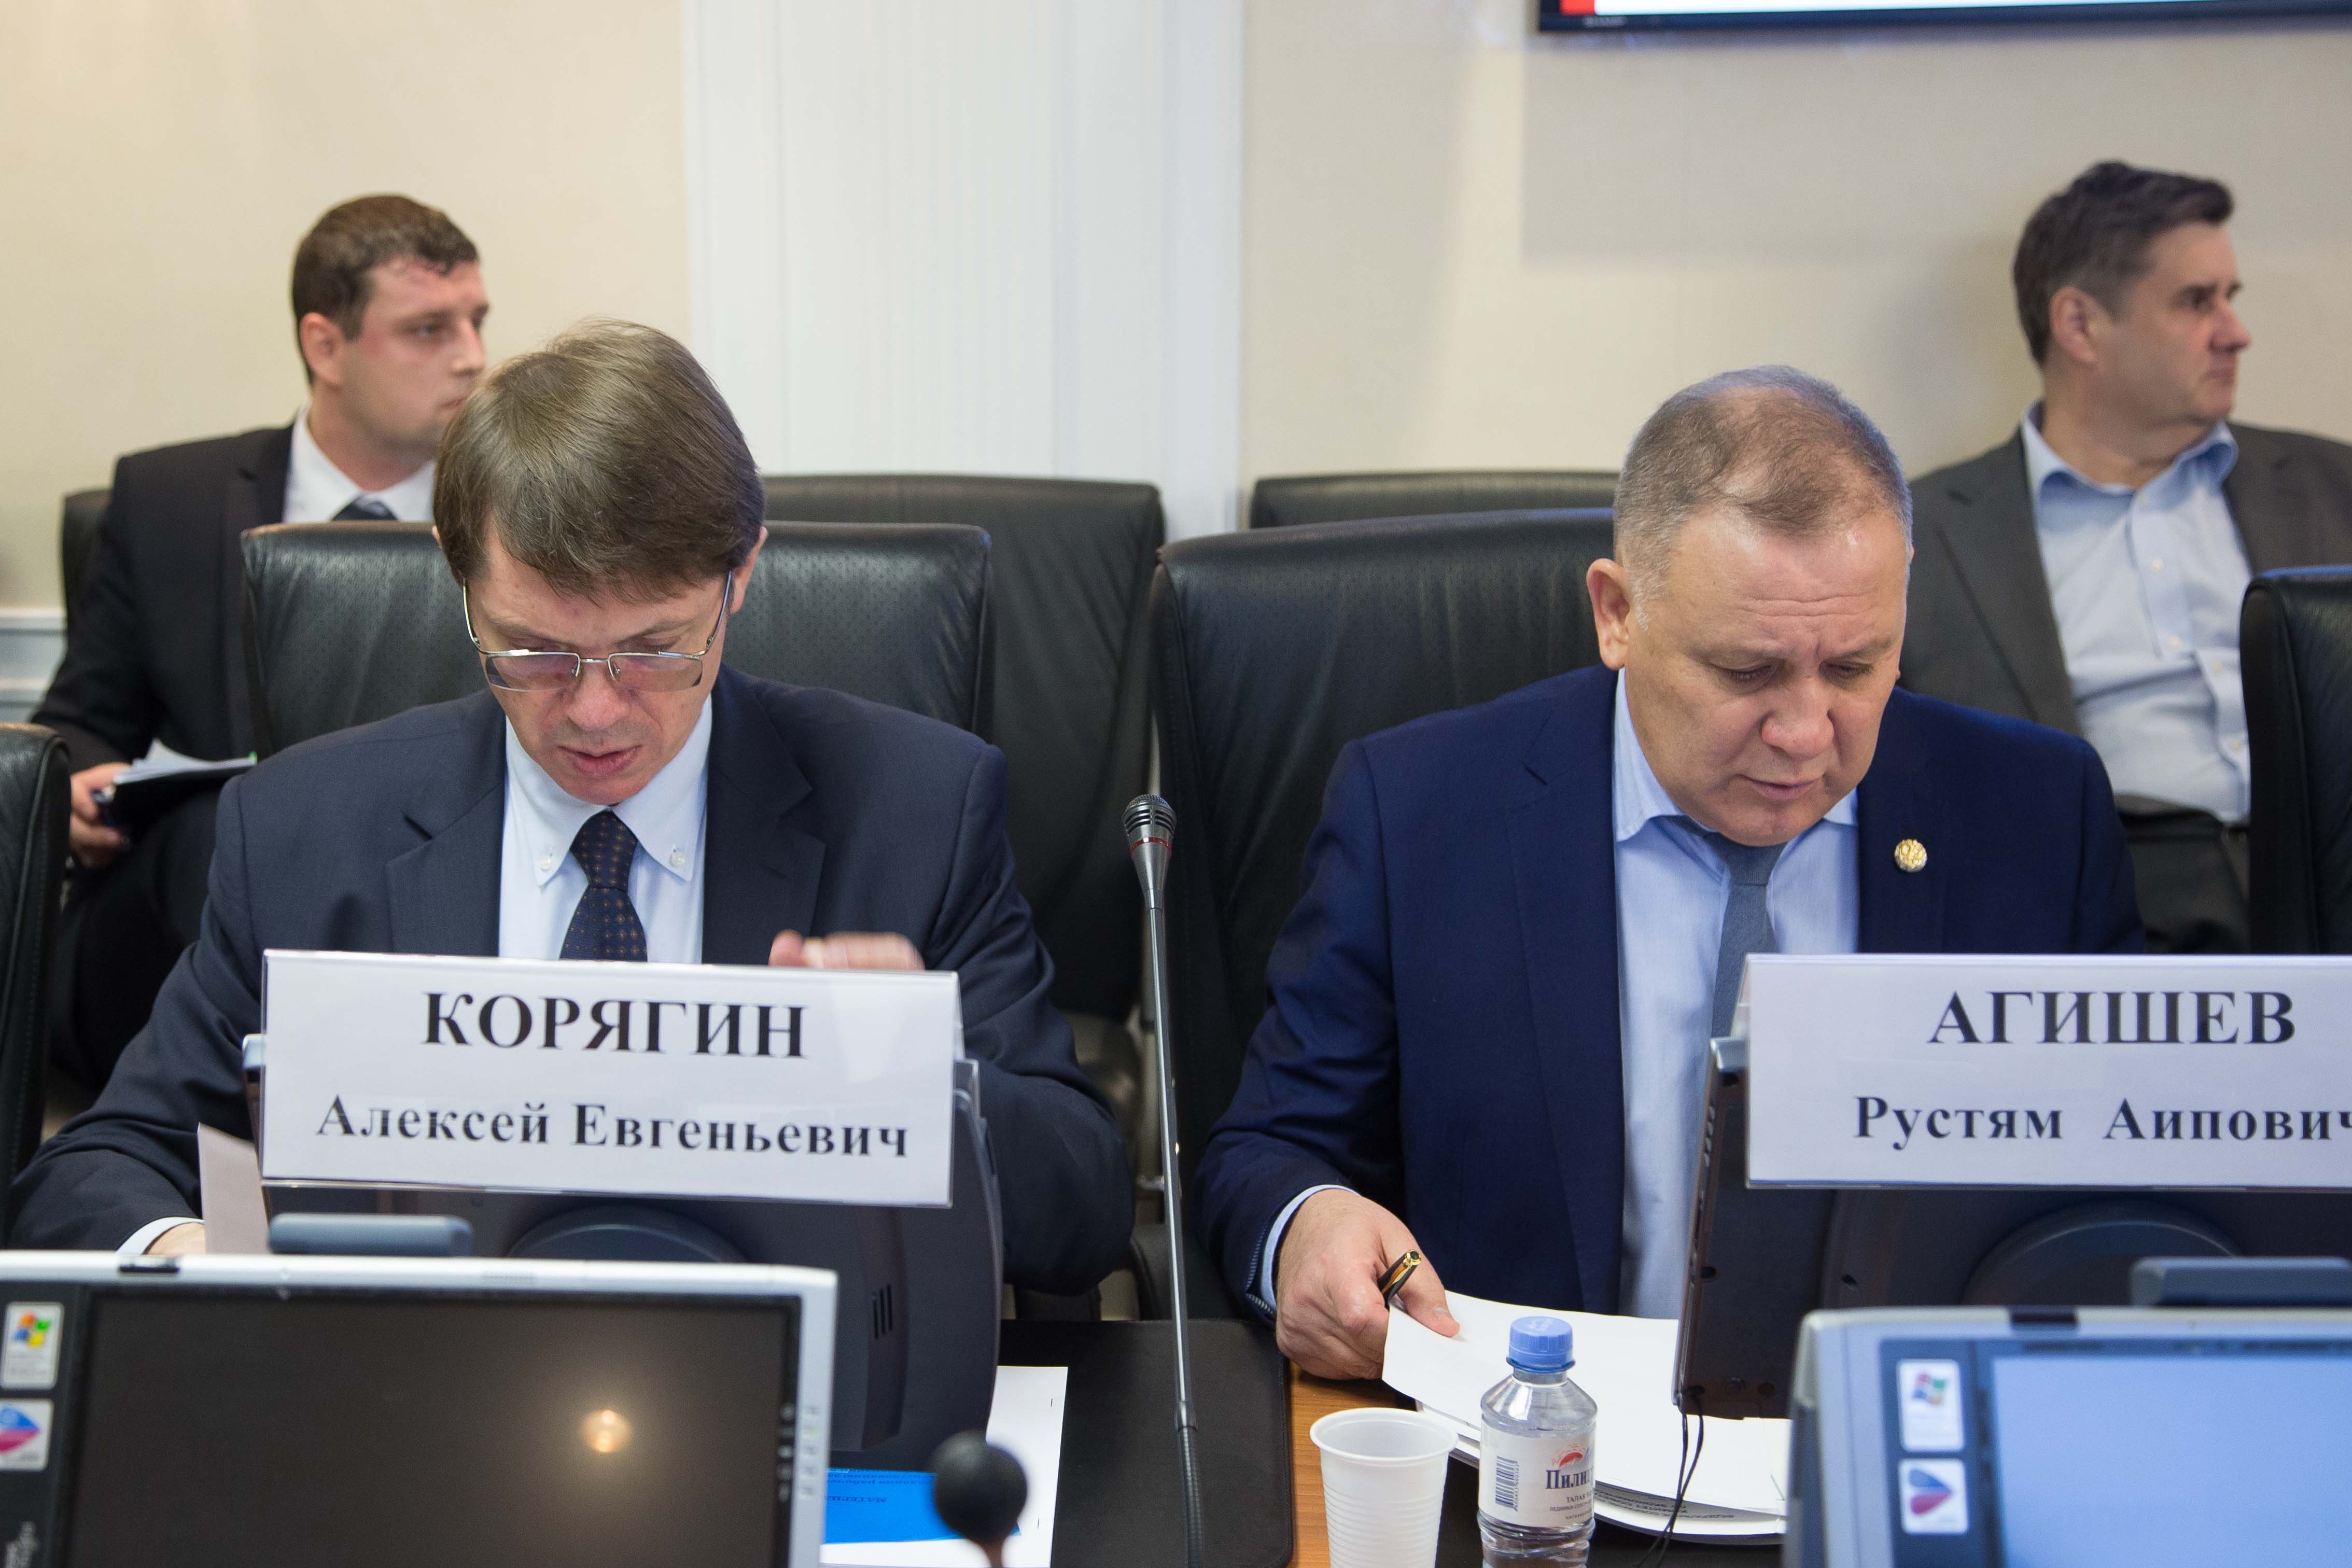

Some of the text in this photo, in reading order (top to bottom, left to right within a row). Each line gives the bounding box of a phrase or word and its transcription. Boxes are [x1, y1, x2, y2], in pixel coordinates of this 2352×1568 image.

[422, 992, 808, 1059] КОРЯГИН
[1928, 991, 2297, 1045] АГИШЕВ
[316, 1095, 907, 1157] Алексей Евгеньевич
[1855, 1096, 2062, 1151] Рустям
